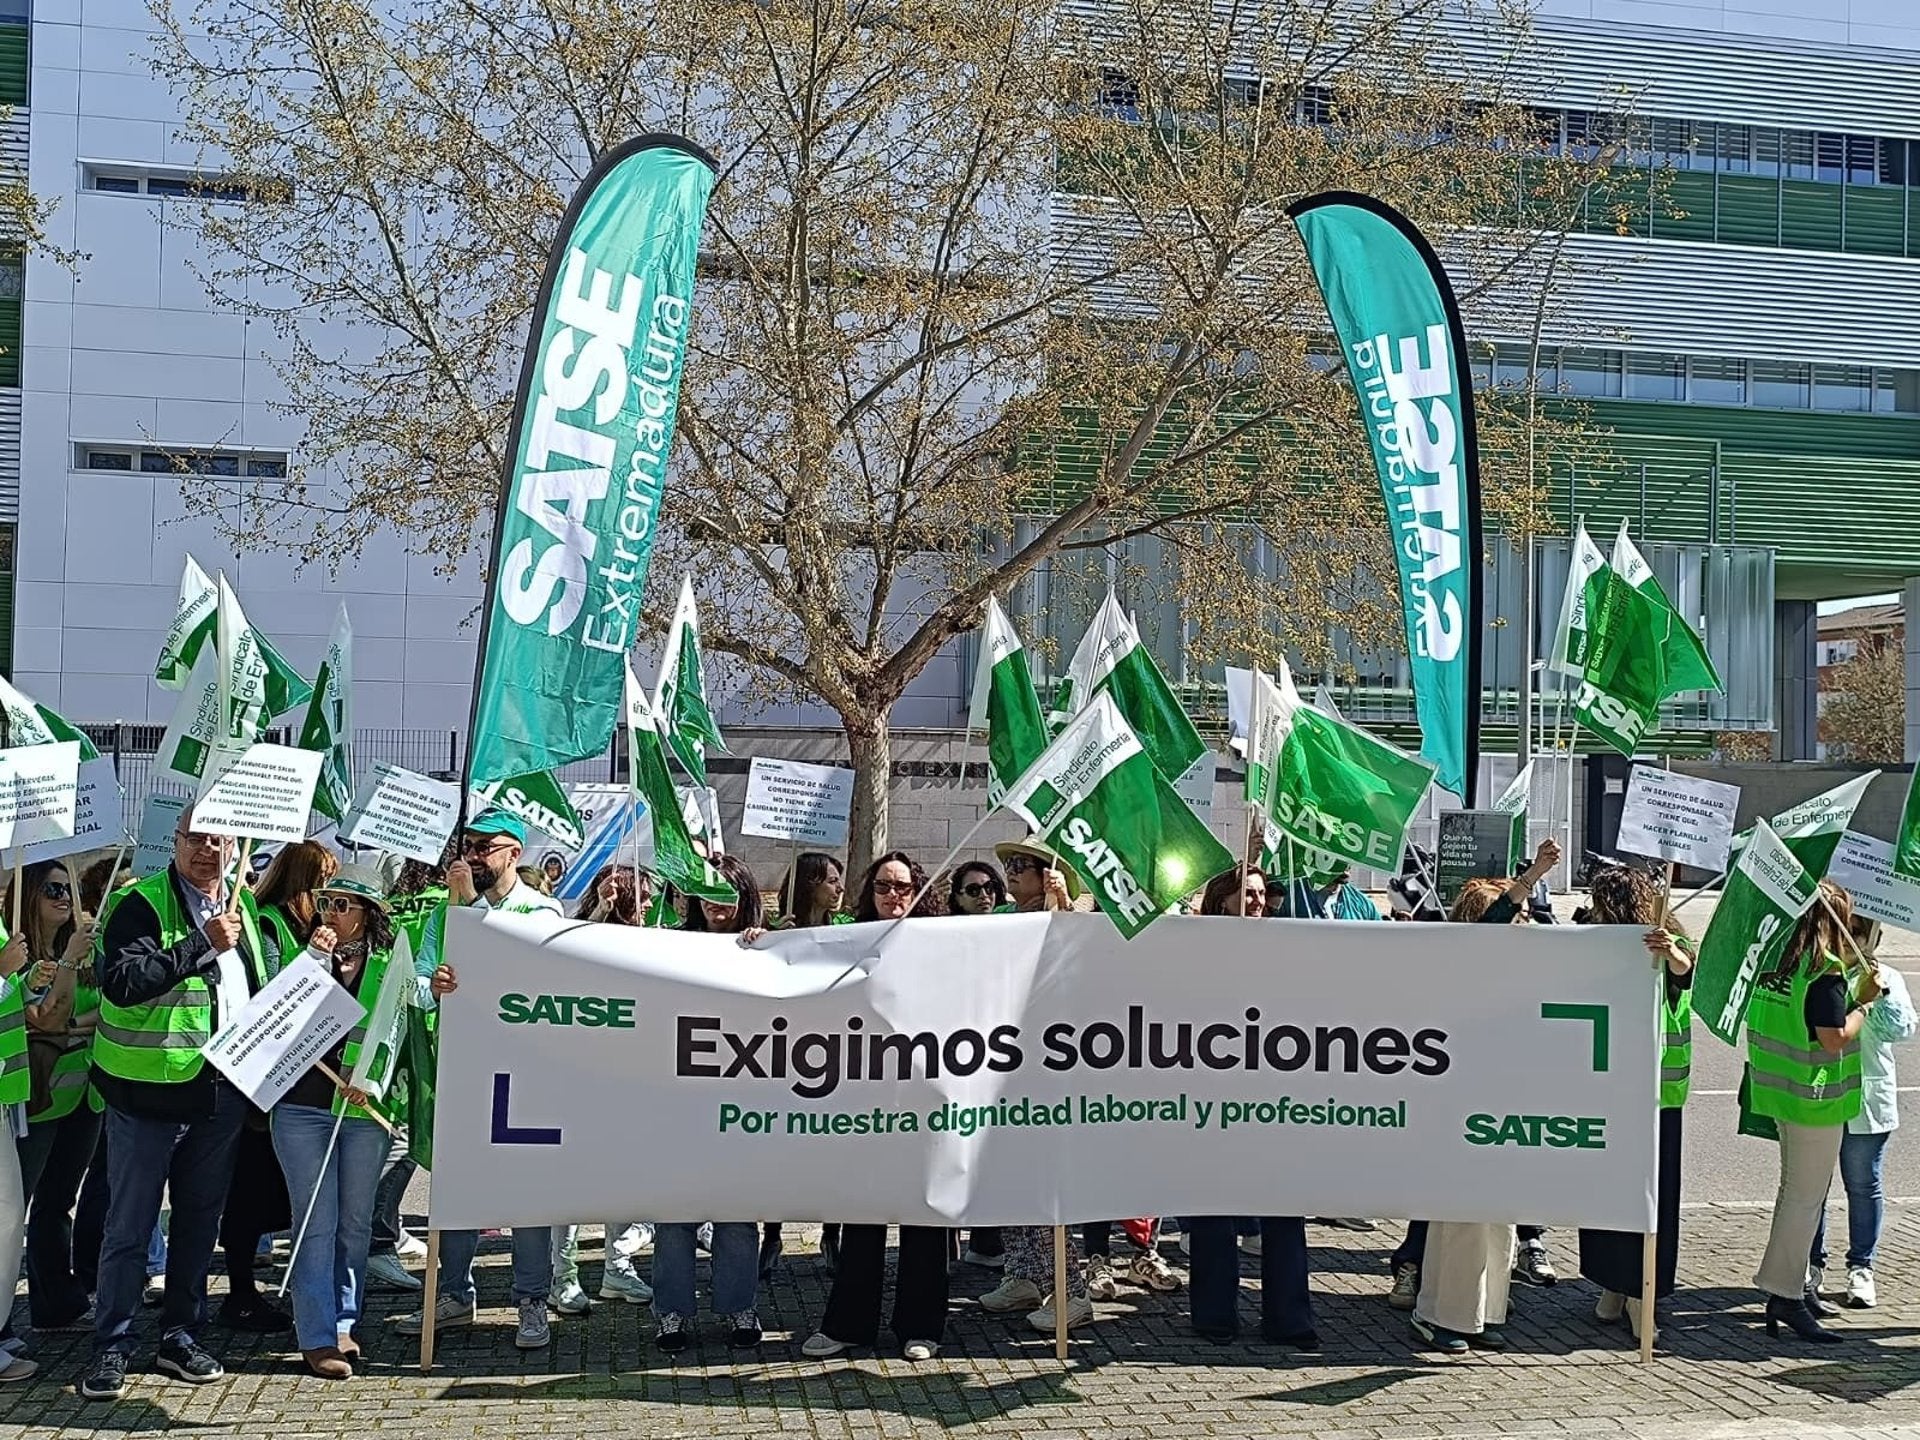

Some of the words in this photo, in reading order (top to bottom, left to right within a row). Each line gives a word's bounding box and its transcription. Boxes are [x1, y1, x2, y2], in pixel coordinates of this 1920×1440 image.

[501, 246, 644, 636] SATSE
[582, 293, 686, 655] Extremadura
[241, 677, 258, 698] de
[191, 682, 218, 736] Sindicato
[1053, 740, 1098, 788] Sindicato
[767, 785, 832, 799] CORRESPONSABLE
[773, 776, 805, 786] SERVICIO
[1065, 782, 1080, 798] de
[374, 779, 385, 787] UN
[385, 783, 418, 798] SERVICIO
[418, 793, 428, 801] DE
[428, 797, 451, 808] SALUD
[376, 791, 440, 816] CORRESPONSABLE
[1641, 785, 1652, 793] UN
[1653, 788, 1687, 801] SERVICIO
[1689, 795, 1698, 803] DE
[1699, 798, 1724, 808] SALUD
[379, 803, 391, 812] NO
[391, 807, 412, 818] TIENE
[746, 803, 777, 812] CAMBIAR
[779, 807, 816, 817] NUESTROS
[1646, 797, 1713, 817] CORRESPONSABLE
[1658, 812, 1680, 822] TIENE
[1773, 816, 1789, 828] de
[1792, 807, 1854, 825] Enfermer
[228, 819, 274, 830] CONTRATOS
[350, 805, 383, 820] CAMBIAR
[383, 815, 419, 831] NUESTROS
[419, 827, 447, 840] TURNOS
[761, 822, 826, 836] CONSTANTEMENTE
[785, 817, 816, 826] TRABAJO
[1277, 792, 1393, 864] SATSE
[1642, 823, 1669, 834] HACER
[1669, 829, 1708, 842] PLANILLAS
[359, 828, 423, 853] CONSTANTEMENTE
[384, 826, 417, 840] TRABAJO
[1657, 838, 1691, 850] ANUALES
[1441, 850, 1460, 858] vida
[1442, 842, 1466, 852] dejen
[1468, 843, 1478, 851] tu
[1846, 848, 1858, 856] UN
[1858, 852, 1894, 867] SERVICIO
[1059, 817, 1156, 927] SATSE
[1840, 856, 1909, 881] CORRESPONSABLE
[1853, 901, 1868, 909] LAS
[1869, 905, 1911, 922] AUSENCIAS
[225, 1043, 237, 1055] UN
[238, 1011, 272, 1043] SERVICIO
[272, 1000, 283, 1010] DE
[284, 977, 308, 999] SALUD
[498, 993, 636, 1028] SATSE
[230, 1003, 298, 1066] CORRESPONSABLE
[297, 982, 319, 1003] TIENE
[274, 1022, 292, 1039] QUE:
[265, 1043, 304, 1079] SUSTITUIR
[304, 1033, 313, 1042] EL
[314, 1015, 333, 1032] 100%
[275, 1076, 285, 1086] DE
[285, 1062, 300, 1076] LAS
[300, 1023, 341, 1061] AUSENCIAS
[676, 1015, 1023, 1098] Exigimos
[1042, 1005, 1450, 1076] soluciones
[719, 1104, 777, 1133] Por
[786, 1107, 918, 1134] nuestra
[927, 1096, 1072, 1137] dignidad
[1080, 1094, 1186, 1124] laboral
[1194, 1102, 1213, 1129] y
[1221, 1096, 1405, 1130] profesional
[1464, 1114, 1606, 1149] SATSE
